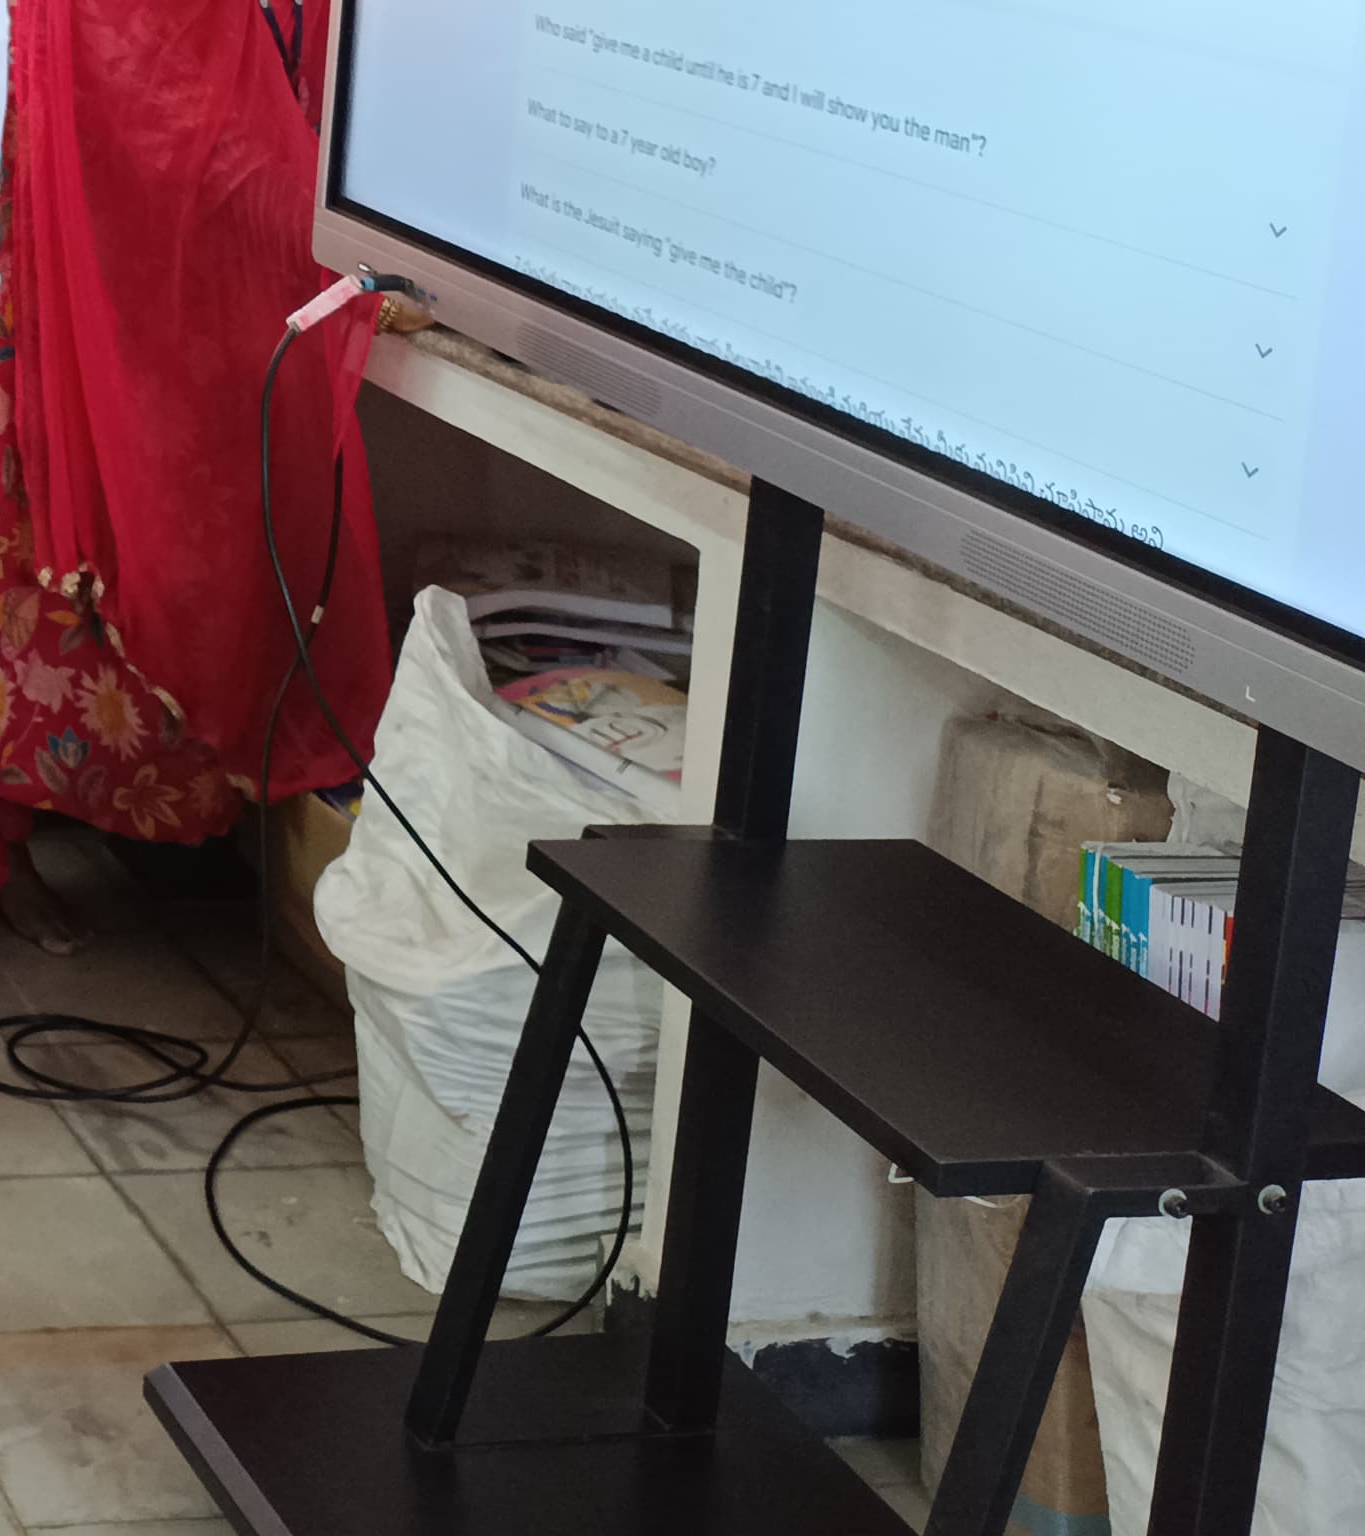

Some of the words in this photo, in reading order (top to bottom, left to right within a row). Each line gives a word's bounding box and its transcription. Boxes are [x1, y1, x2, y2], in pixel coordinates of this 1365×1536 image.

[536, 15, 561, 37] Who
[563, 26, 587, 44] said
[620, 42, 640, 59] me
[642, 48, 650, 62] a
[652, 49, 684, 72] child
[685, 61, 715, 80] until
[717, 65, 735, 86] he
[737, 71, 749, 90] is
[751, 74, 761, 91] 7
[762, 81, 789, 101] and
[800, 91, 825, 111] will
[827, 97, 867, 123] show
[871, 112, 900, 132] you
[904, 118, 930, 141] the
[528, 99, 557, 124] What
[559, 111, 572, 128] to
[573, 118, 593, 138] say
[596, 123, 608, 141] to
[610, 130, 618, 144] a
[621, 129, 631, 145] 7
[631, 138, 658, 157] year
[661, 145, 681, 165] old
[683, 150, 716, 176] boy?
[521, 184, 549, 208] What
[552, 200, 561, 214] is
[563, 201, 582, 221] the
[584, 209, 620, 236] Jesuit
[622, 225, 663, 257] saying
[699, 255, 721, 275] me
[724, 262, 746, 285] the
